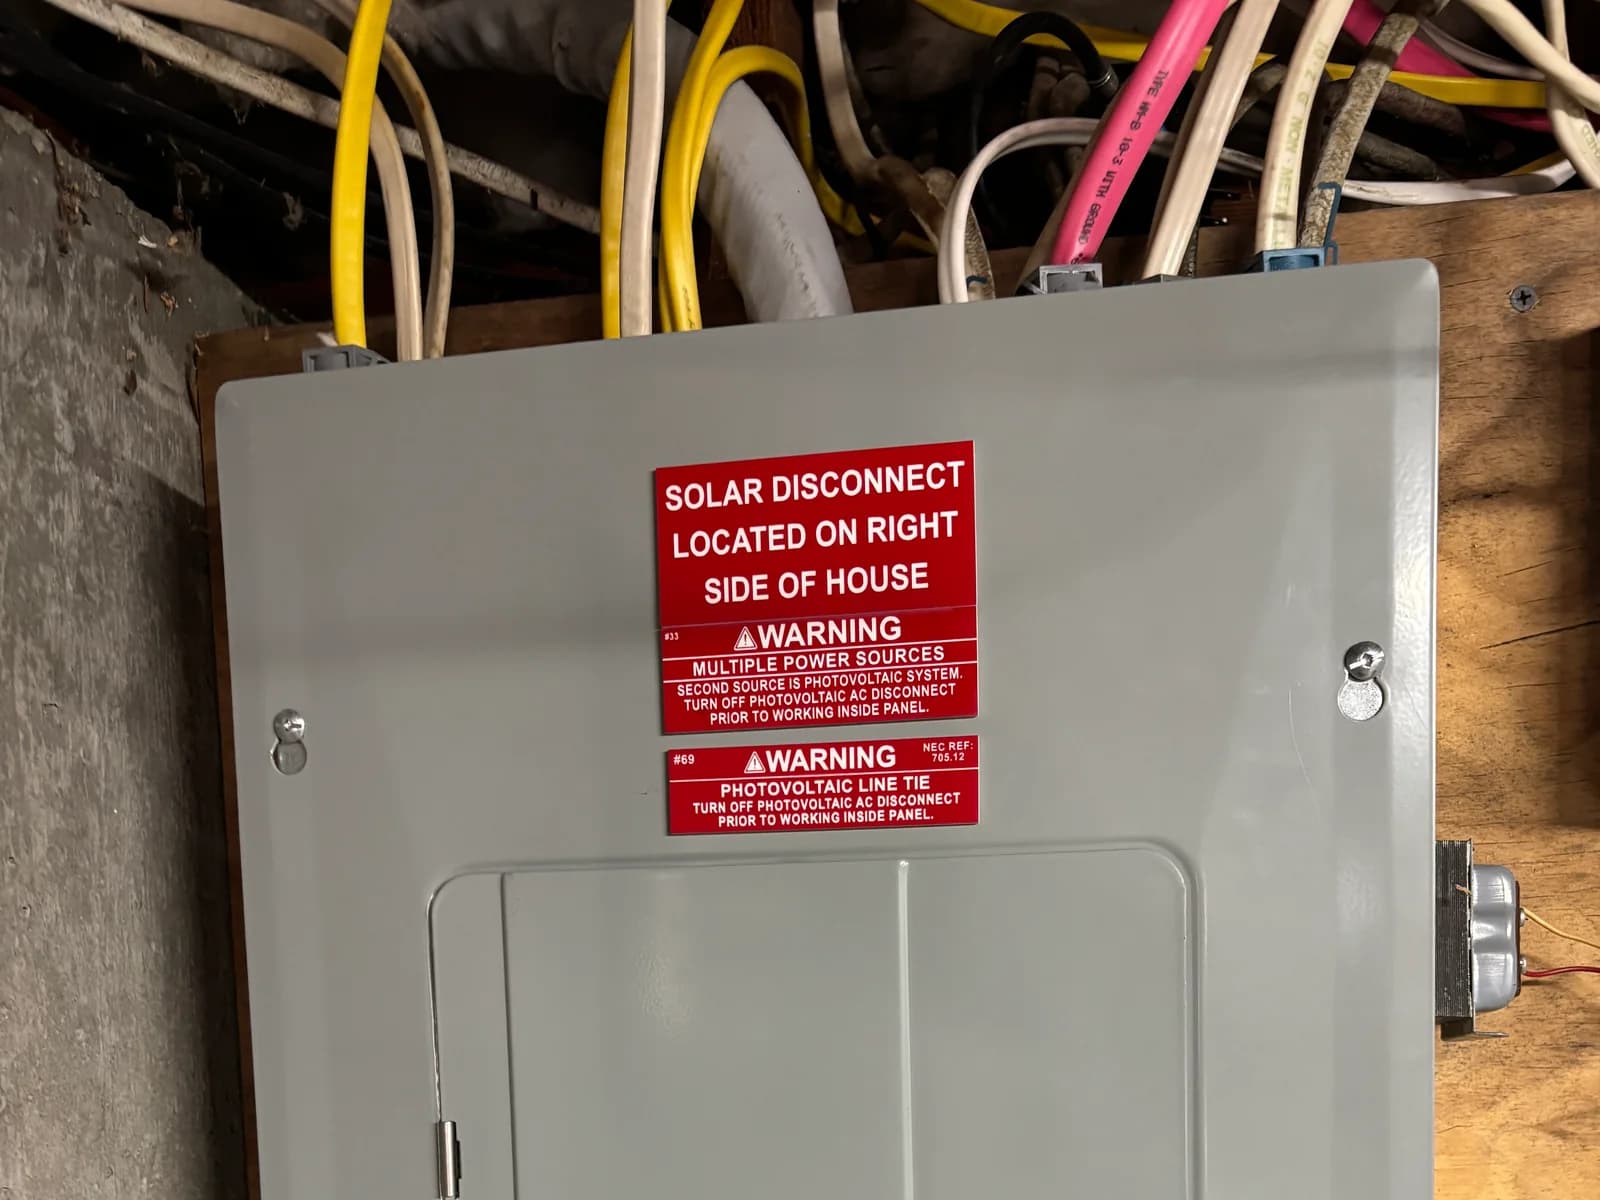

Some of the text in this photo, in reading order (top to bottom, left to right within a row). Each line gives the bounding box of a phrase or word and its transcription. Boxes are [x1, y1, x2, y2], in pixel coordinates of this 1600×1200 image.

[1147, 69, 1170, 97] TYPE
[1096, 170, 1117, 198] WITH
[1078, 203, 1102, 245] GROUND
[665, 460, 965, 511] SOLAR DISCONNECT
[673, 510, 958, 558] LOCATED ON RIGHT
[705, 562, 928, 604] SIDE OF HOUSE
[757, 616, 901, 649] WARNING
[693, 646, 944, 676] MULTIPLE POWER SOURCES
[677, 667, 962, 696] SECOND SOURCE IS PHOTOVOLTAIC SYSTEM.
[684, 683, 956, 711] TURN OFF PHOTOVOLTAIC AC DISCONNECT
[710, 701, 929, 725] PRIOR TO WORKING INSIDE PANEL.
[674, 754, 694, 764] #69
[766, 745, 896, 772] WARNING
[923, 741, 974, 752] NEC REF:
[932, 752, 964, 762] 705.12
[721, 775, 930, 798] PHOTOVOLTAIC LINE TIE
[693, 792, 960, 814] TURN OFF PHOTOVOLTAIC AC DISCONNECT
[718, 808, 933, 827] PRIOR TO WORKING INSIDE PANEL.
